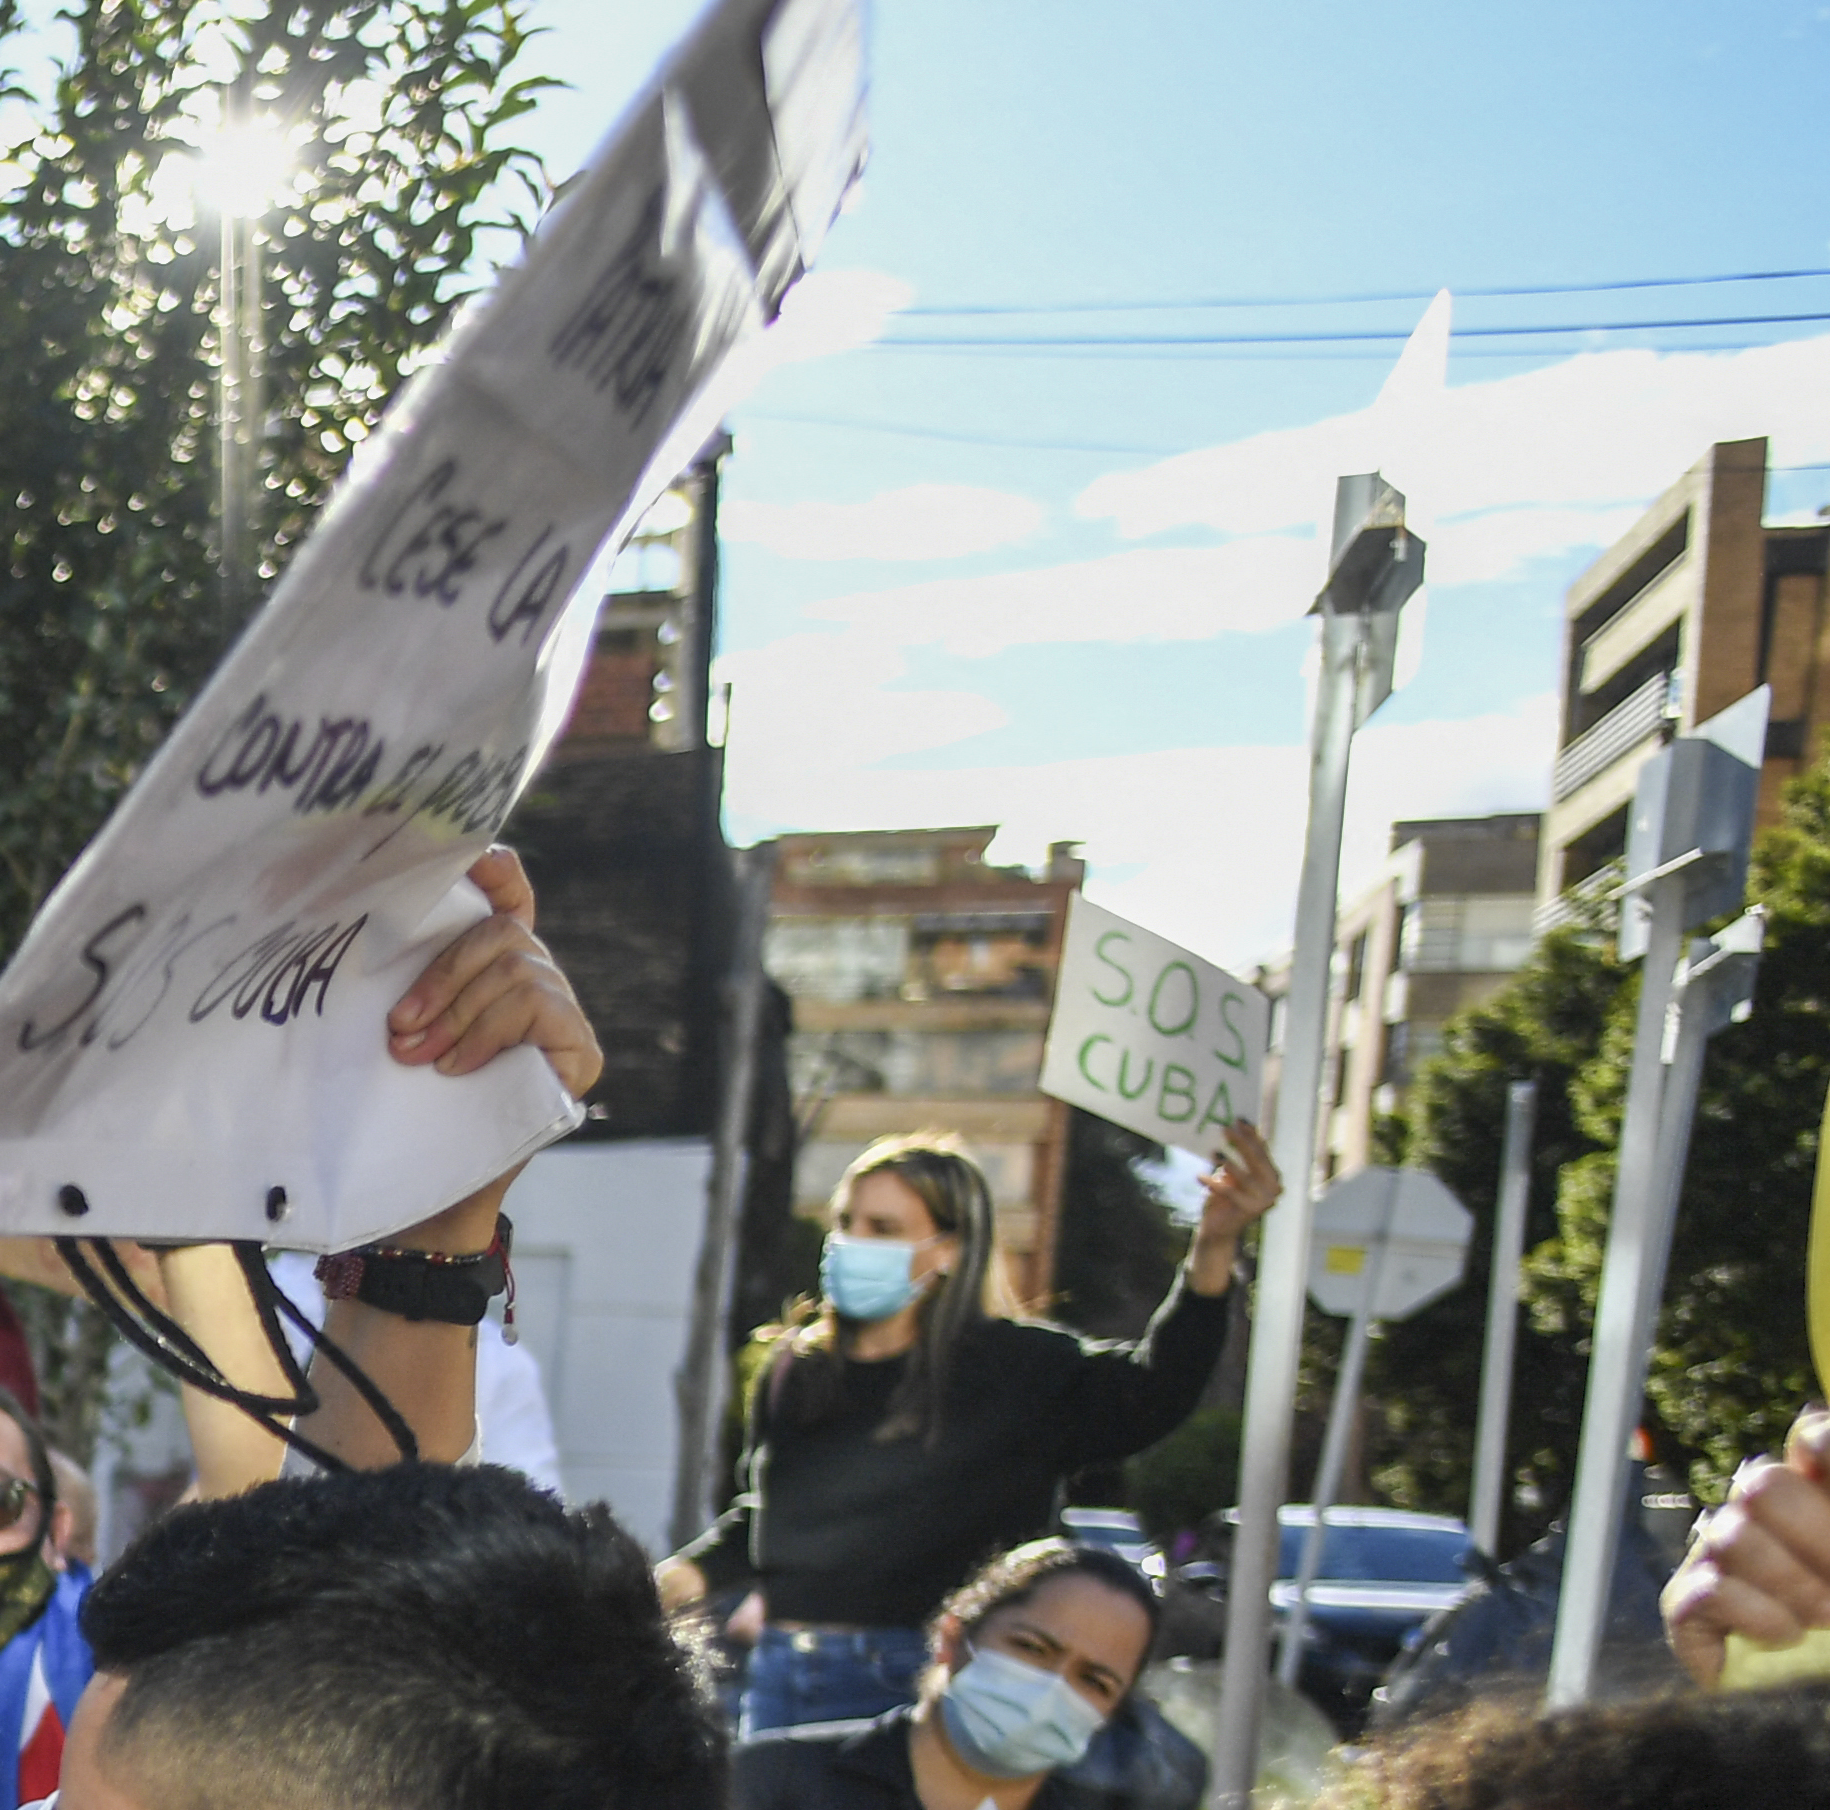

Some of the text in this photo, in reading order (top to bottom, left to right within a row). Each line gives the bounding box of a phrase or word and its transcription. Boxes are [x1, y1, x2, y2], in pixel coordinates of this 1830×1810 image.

[356, 455, 570, 647] CESE LA
[197, 692, 386, 815] CONTRA
[1077, 1032, 1236, 1135] CUBA
